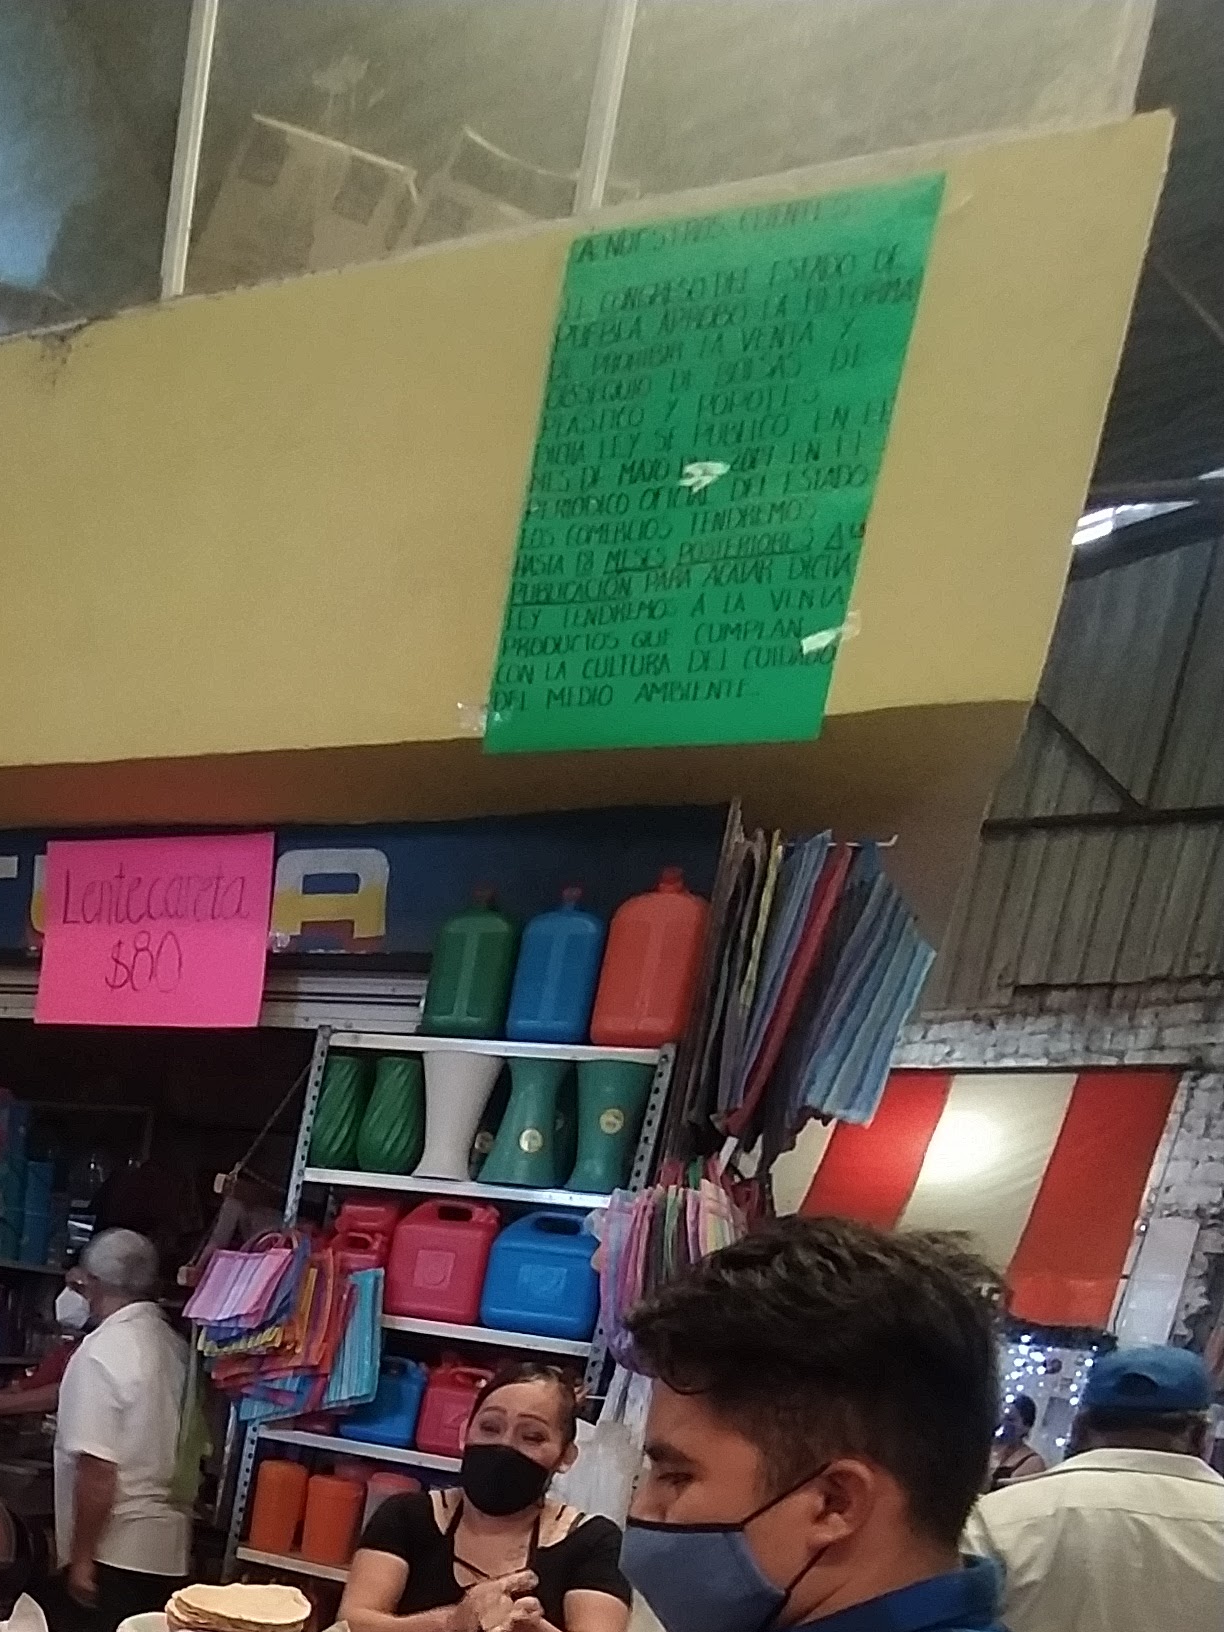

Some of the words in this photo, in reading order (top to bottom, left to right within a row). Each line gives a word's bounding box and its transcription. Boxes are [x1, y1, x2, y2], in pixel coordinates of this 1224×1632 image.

[769, 251, 857, 286] ESTADO
[874, 243, 901, 269] DE
[555, 315, 643, 350] PUEBLA
[762, 294, 788, 318] LA
[550, 357, 572, 378] DE
[701, 333, 725, 355] LA
[739, 320, 816, 351] VENTA
[840, 315, 857, 337] Y
[716, 353, 802, 384] BOLSAS
[599, 434, 641, 458] LEY
[652, 429, 676, 451] SE
[814, 406, 849, 430] EN
[665, 400, 677, 419] Y
[530, 471, 570, 492] MES
[619, 458, 671, 483] MAYO
[791, 439, 822, 462] EN
[730, 478, 766, 500] DEL
[784, 464, 870, 492] ESTADO
[520, 527, 556, 548] LOS
[566, 515, 674, 546] COMERCIOS
[691, 499, 821, 533] TENDREMOS
[515, 553, 565, 576] HASTA
[605, 545, 668, 570] MESES
[678, 529, 815, 562] POSTERIORES
[646, 568, 693, 589] PARA
[788, 554, 855, 579] DICHA
[506, 609, 540, 630] LEY
[564, 599, 677, 626] TENDREMOS
[691, 594, 707, 614] A
[724, 591, 747, 611] LA
[768, 585, 847, 611] VENTA
[501, 632, 620, 656] PRODUCTOS
[632, 627, 672, 646] QUE
[695, 619, 803, 642] CUMPLAN
[496, 662, 535, 683] CON
[546, 660, 568, 678] LA
[582, 654, 672, 677] CULTURA
[689, 650, 726, 671] DEL
[493, 690, 527, 709] DEL
[547, 685, 614, 706] MEDIO
[61, 860, 251, 926] Lentecareta
[104, 930, 183, 994] $80
